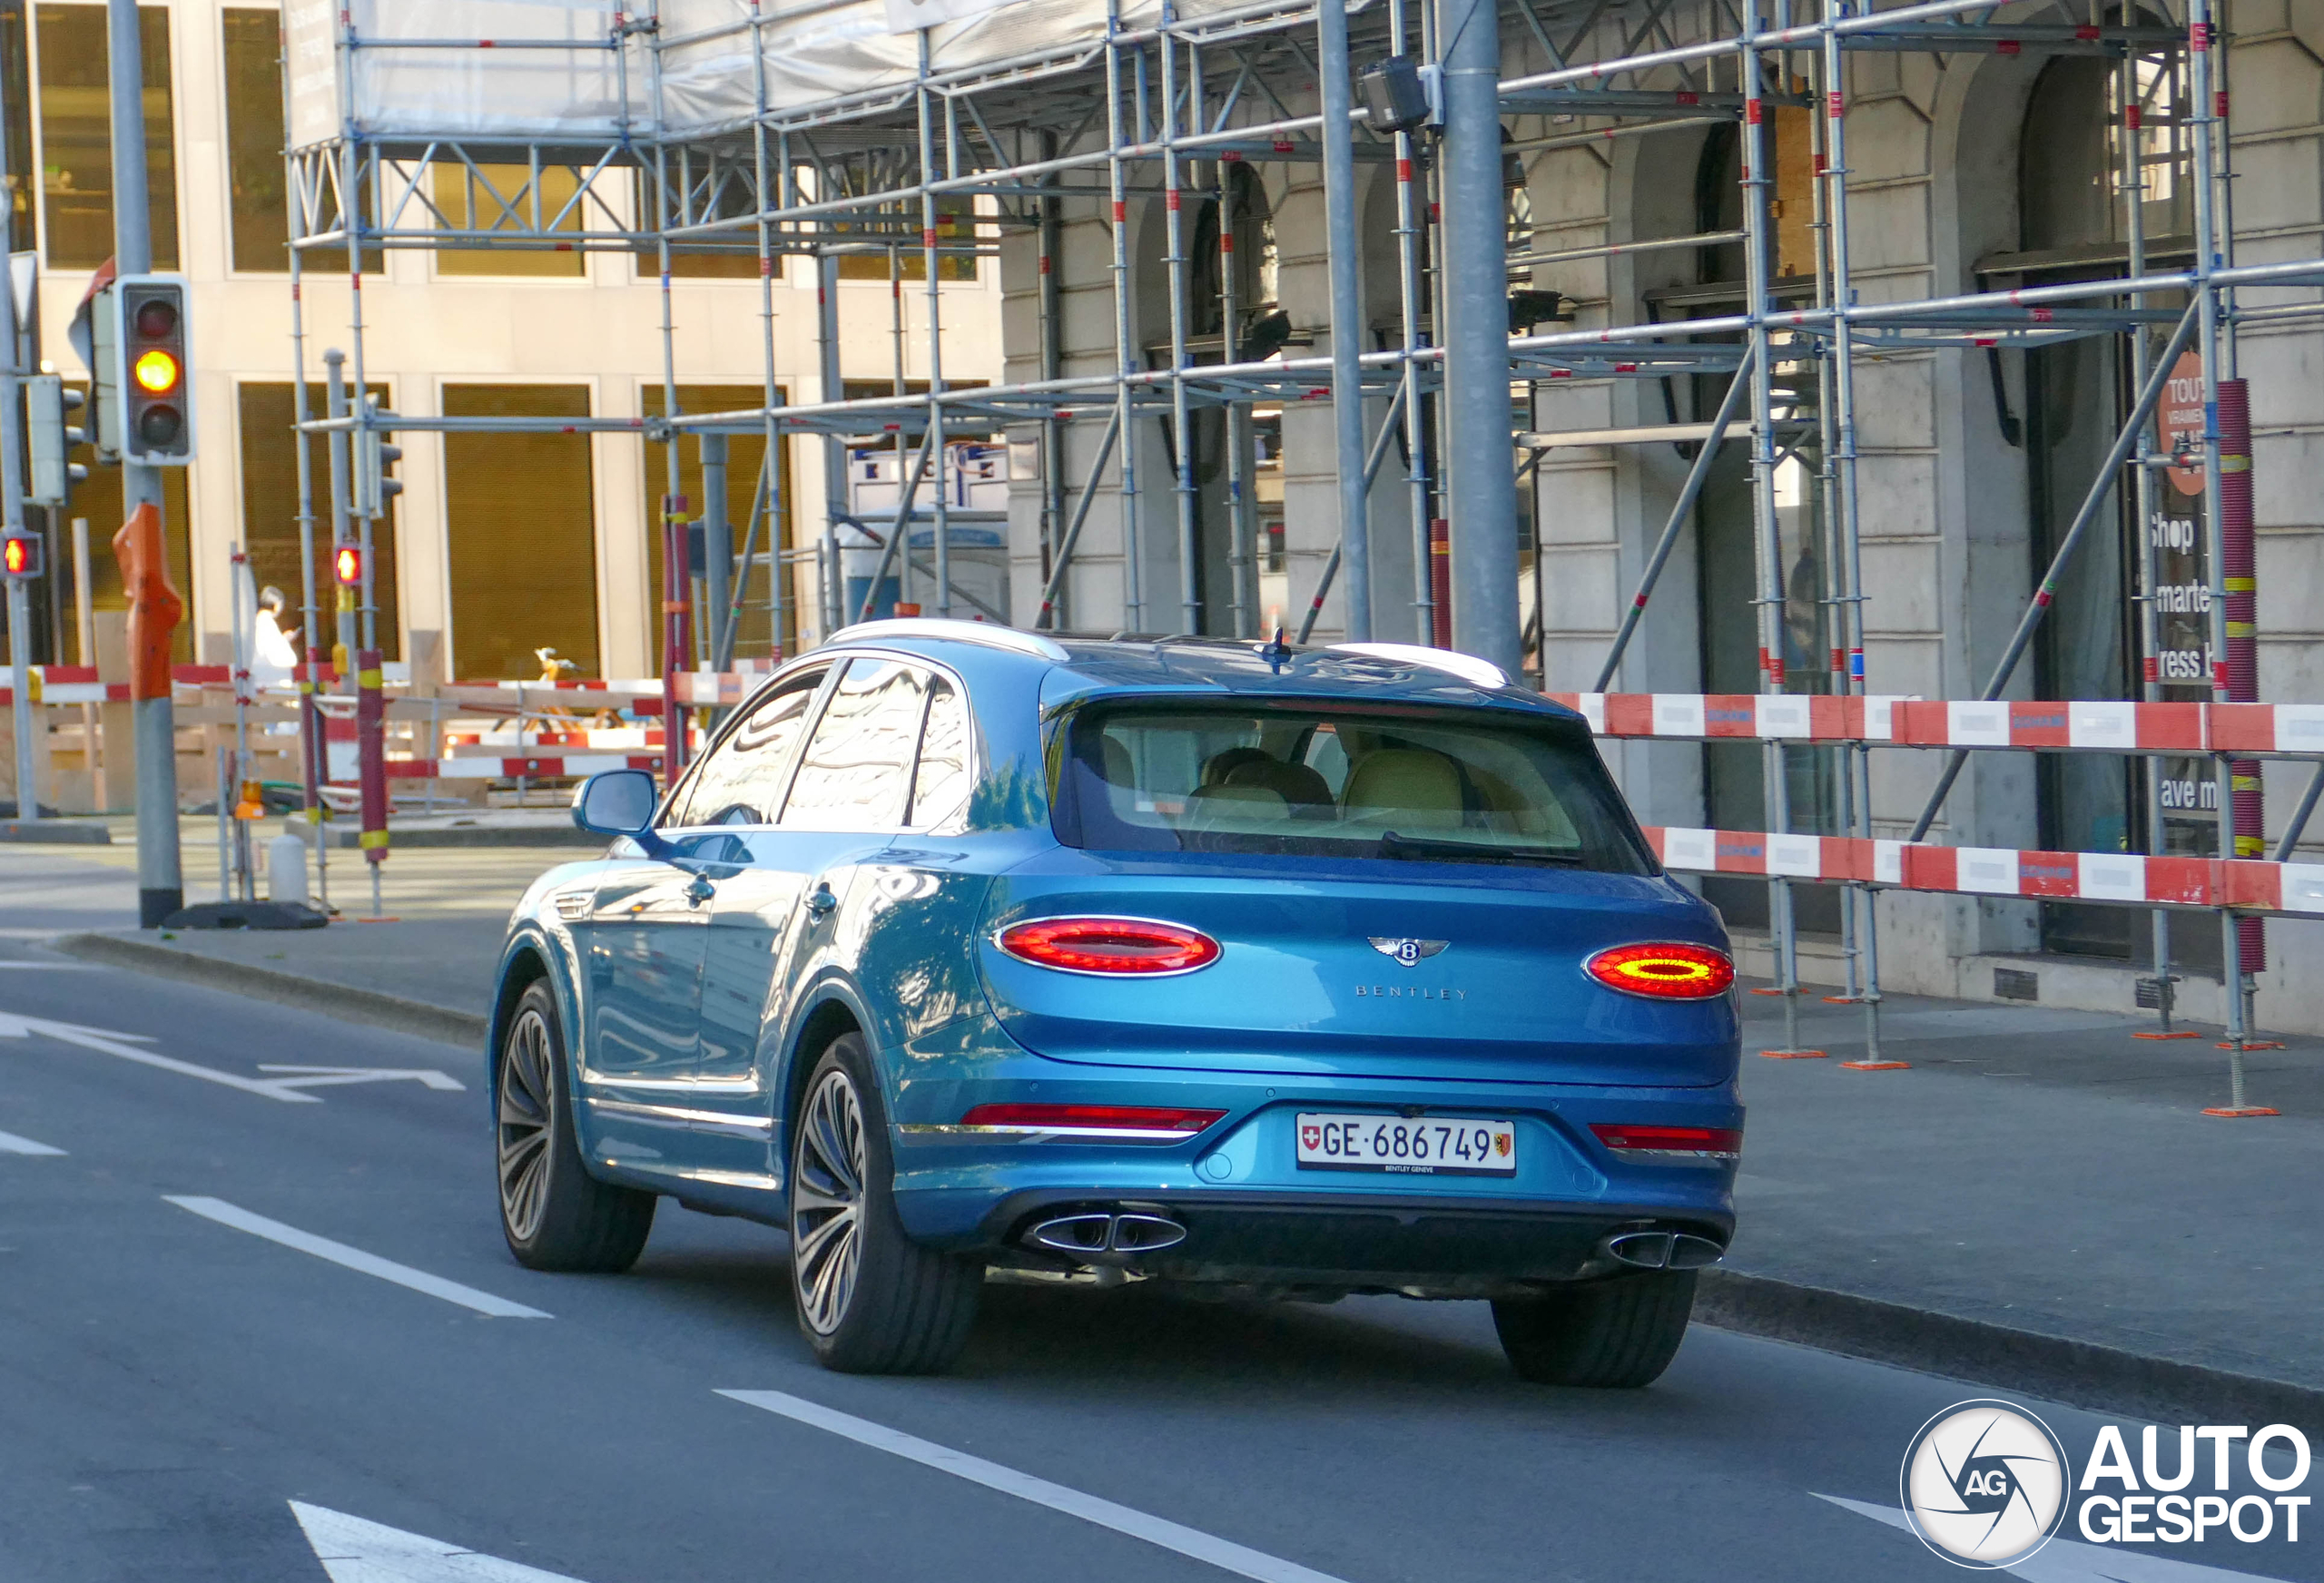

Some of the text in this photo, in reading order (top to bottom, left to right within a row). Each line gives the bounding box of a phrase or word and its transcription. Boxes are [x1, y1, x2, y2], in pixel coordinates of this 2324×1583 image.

[2156, 642, 2201, 678] ress
[2162, 780, 2195, 808] ave
[1355, 985, 1468, 1000] BENTLEY
[1384, 1165, 1411, 1173] BENTLEY
